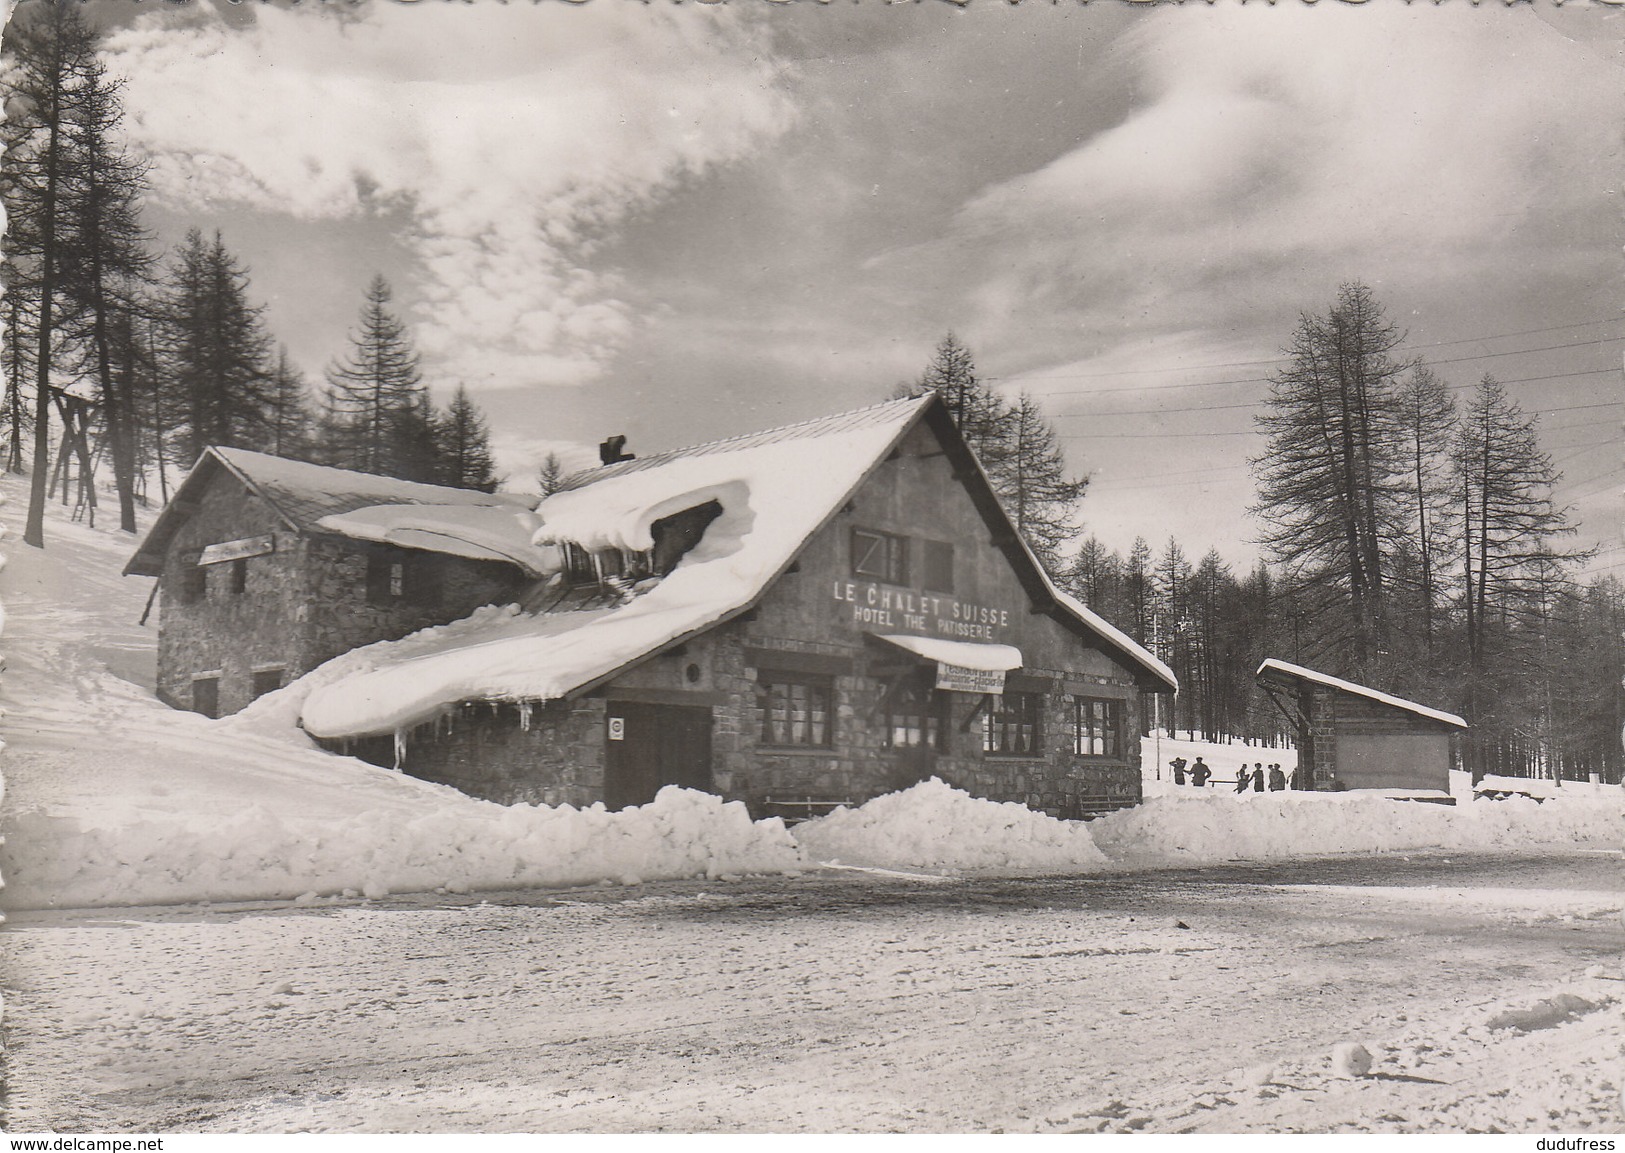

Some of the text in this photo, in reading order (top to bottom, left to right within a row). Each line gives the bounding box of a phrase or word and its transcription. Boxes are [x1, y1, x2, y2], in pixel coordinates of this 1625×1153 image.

[834, 581, 1008, 627] LE CHALET SUISSE
[853, 605, 993, 640] HOTEL THE PATISSERIE
